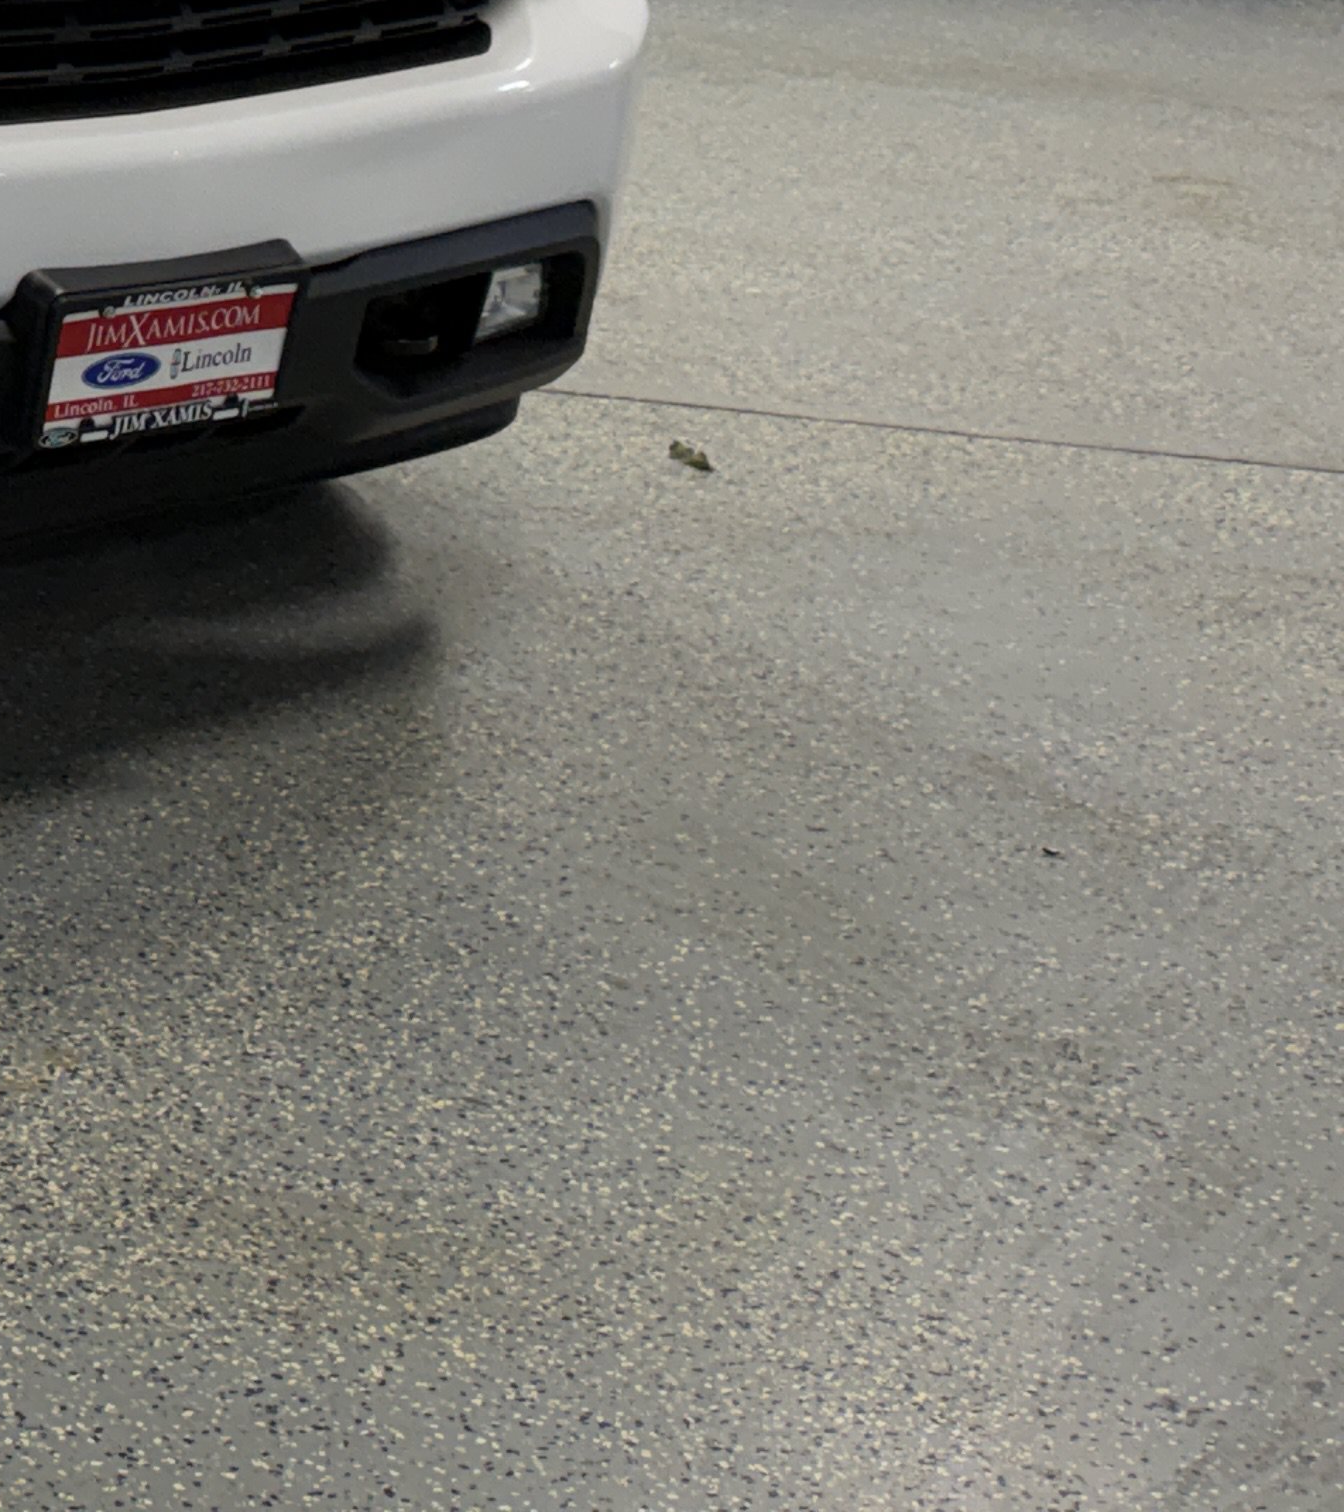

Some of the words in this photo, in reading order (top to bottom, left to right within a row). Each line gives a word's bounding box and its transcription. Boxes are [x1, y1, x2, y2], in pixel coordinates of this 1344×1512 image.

[97, 356, 145, 384] Ford
[181, 343, 252, 373] Lincoln
[123, 394, 140, 409] IL
[110, 415, 147, 440] JIM
[149, 399, 212, 427] XAMIS
